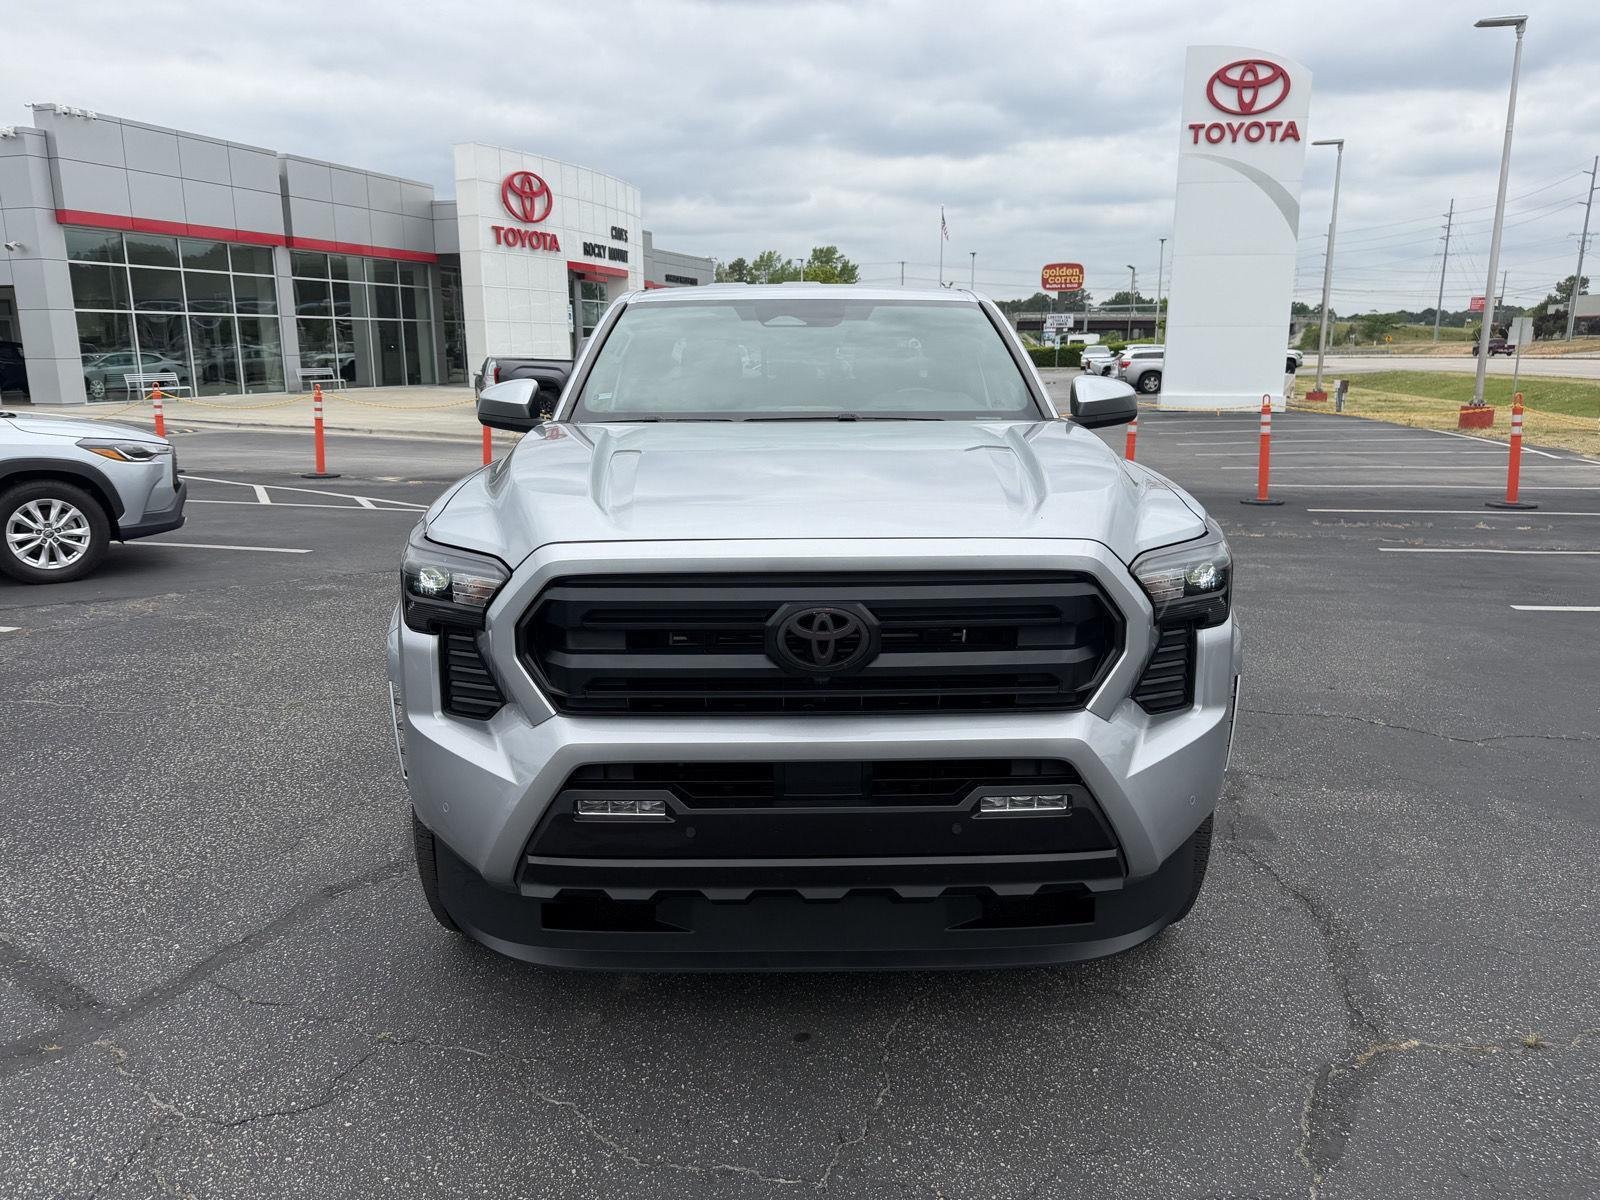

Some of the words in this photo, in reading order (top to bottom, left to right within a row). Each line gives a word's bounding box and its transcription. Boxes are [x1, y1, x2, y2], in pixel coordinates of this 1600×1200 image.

[1188, 121, 1301, 144] TOYOTA
[491, 225, 561, 252] TOYOTA
[583, 241, 607, 259] ROCKY
[1043, 267, 1079, 278] golden
[1048, 274, 1083, 283] corral
